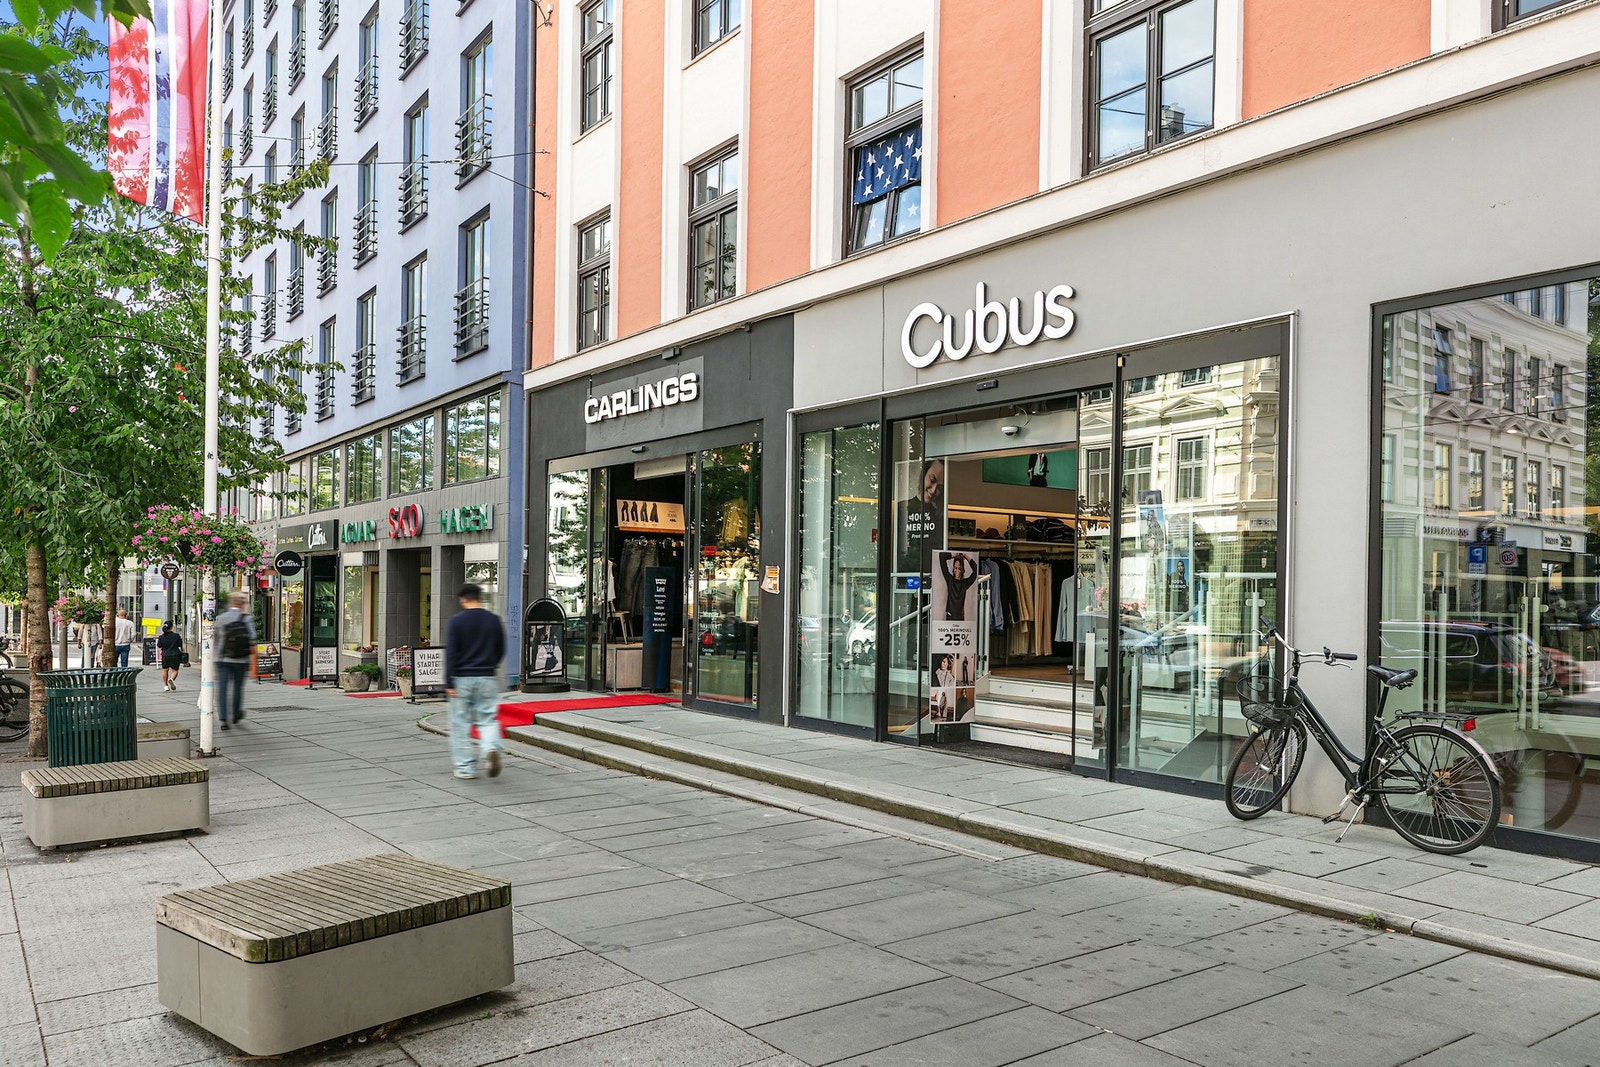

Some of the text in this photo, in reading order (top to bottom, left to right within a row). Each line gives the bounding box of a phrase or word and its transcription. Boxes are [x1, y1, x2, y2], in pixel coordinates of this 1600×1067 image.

[900, 281, 1078, 369] Cubus
[584, 372, 699, 424] CARLINGS
[340, 520, 377, 543] AGNAR
[440, 503, 495, 534] HAGEN
[906, 522, 936, 531] MERNO
[939, 633, 970, 646] -25%
